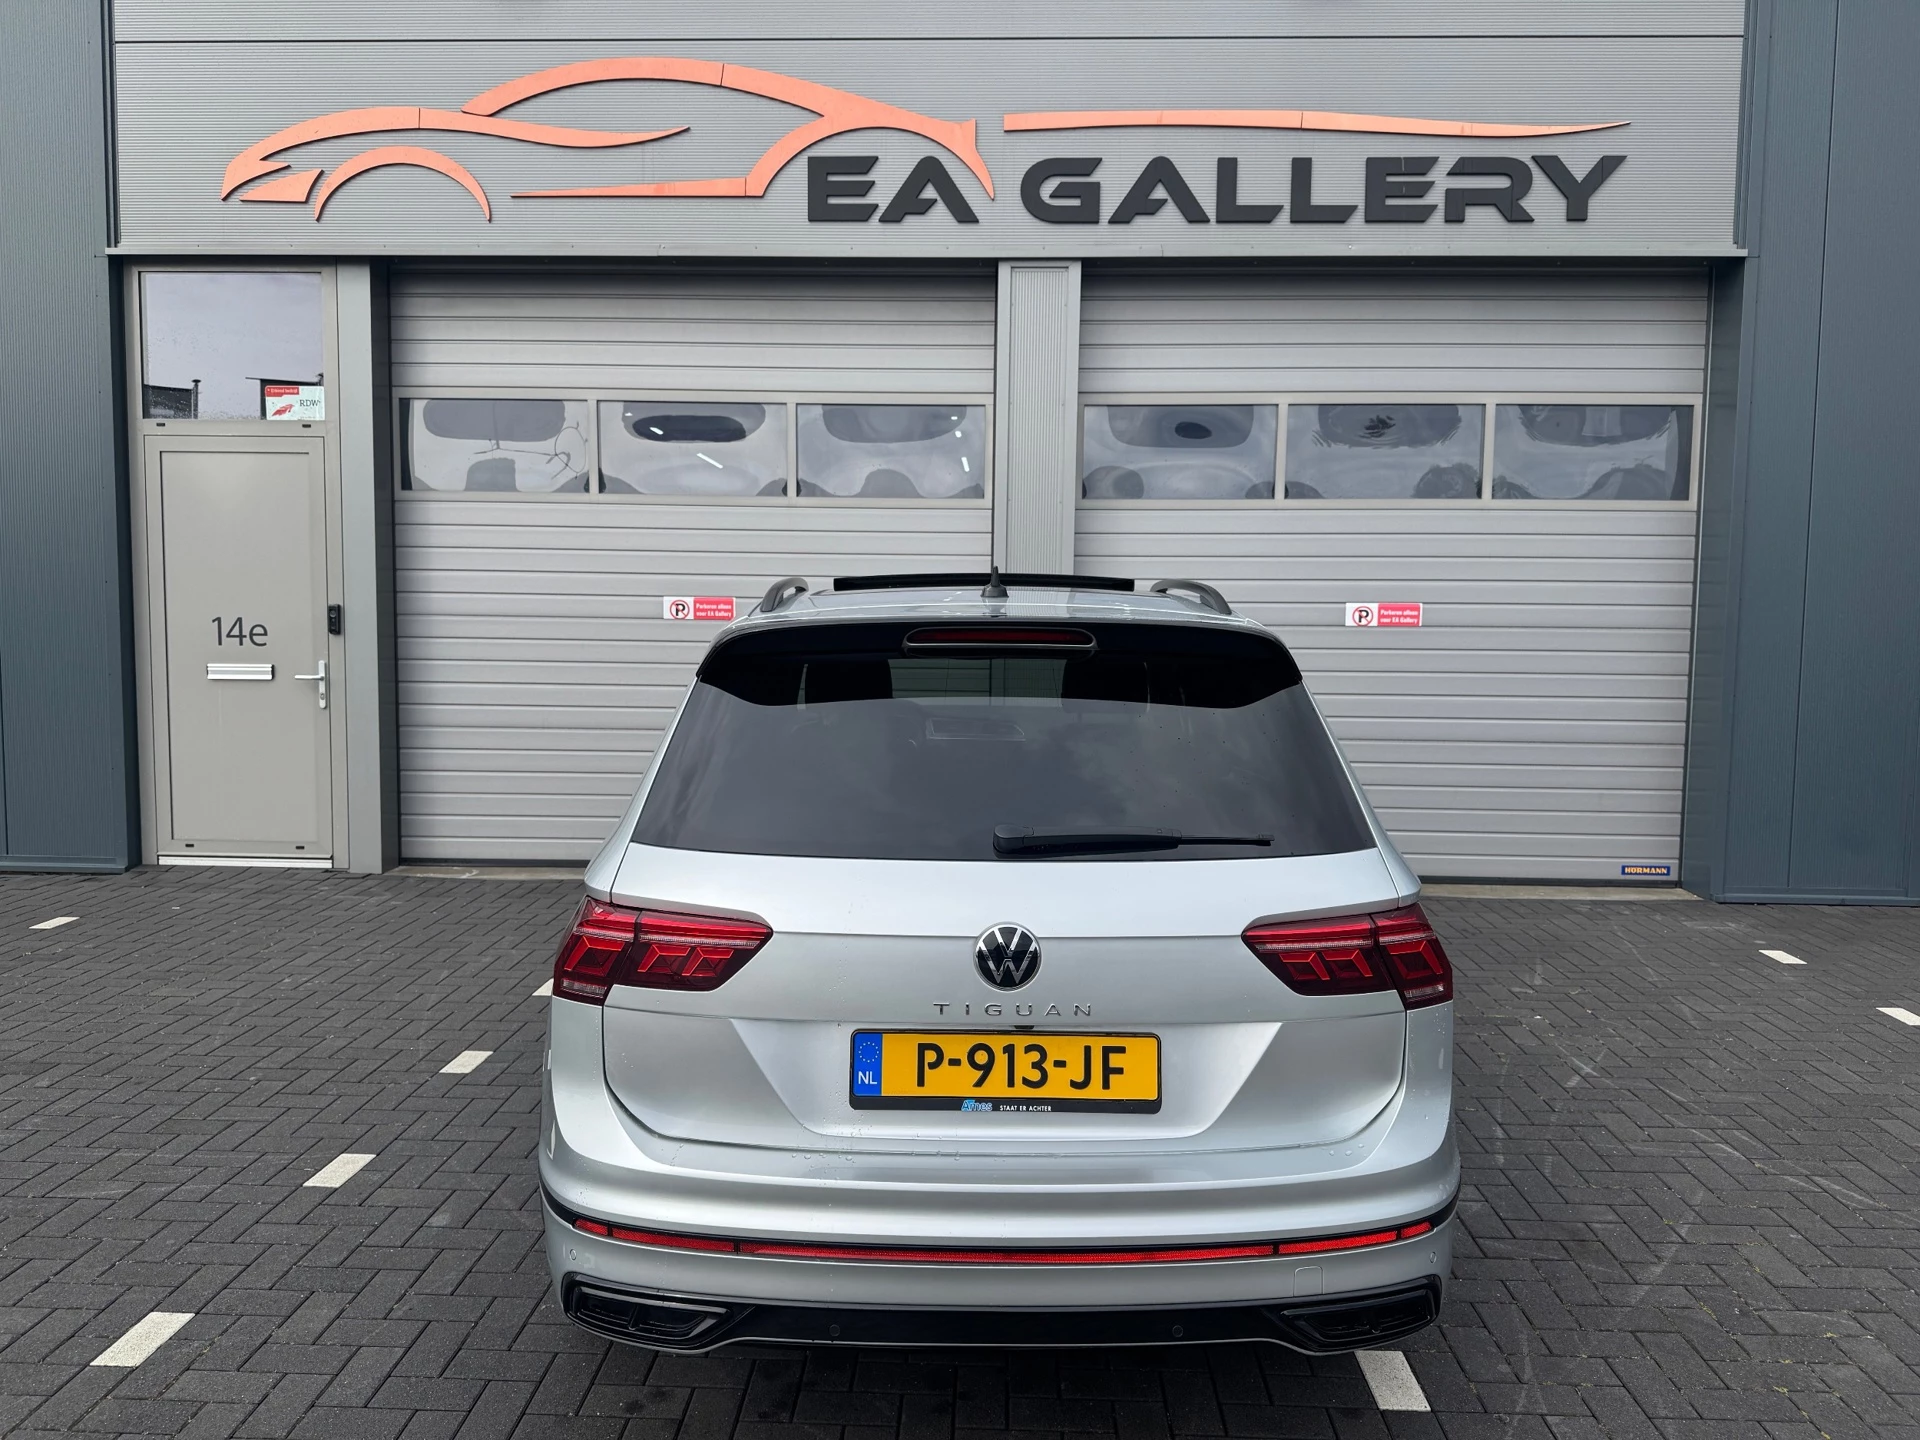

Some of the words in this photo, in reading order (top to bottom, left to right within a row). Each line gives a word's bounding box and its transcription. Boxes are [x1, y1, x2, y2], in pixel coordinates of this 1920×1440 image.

[807, 155, 980, 224] EA
[1020, 155, 1627, 224] GALLERY
[300, 399, 319, 407] RDW
[211, 616, 269, 647] 14e
[933, 1002, 1092, 1017] TIGUAN
[916, 1042, 1127, 1091] P-913-JF
[858, 1071, 878, 1086] NL
[1029, 1105, 1052, 1113] ACHTER
